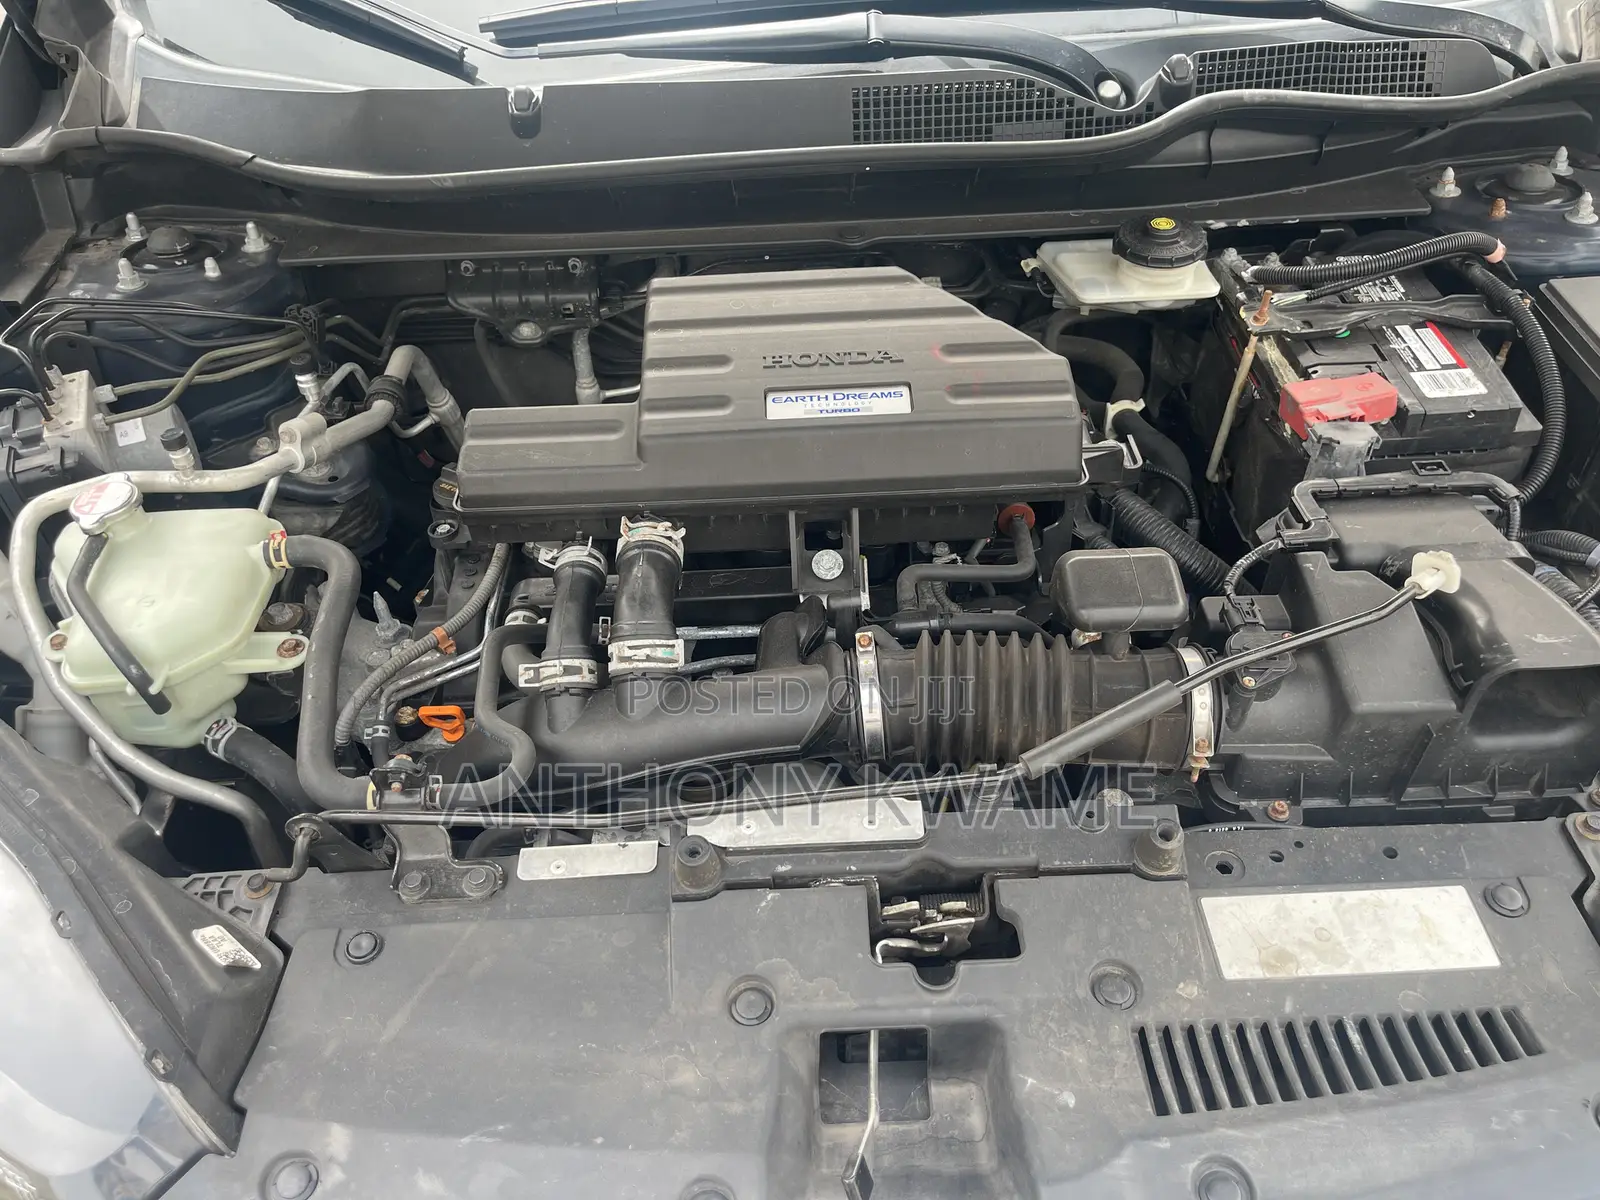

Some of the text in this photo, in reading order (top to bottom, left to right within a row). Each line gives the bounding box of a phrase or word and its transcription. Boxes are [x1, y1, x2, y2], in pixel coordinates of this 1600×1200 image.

[763, 351, 904, 368] HONDA
[771, 391, 904, 404] EARTH DREAMS
